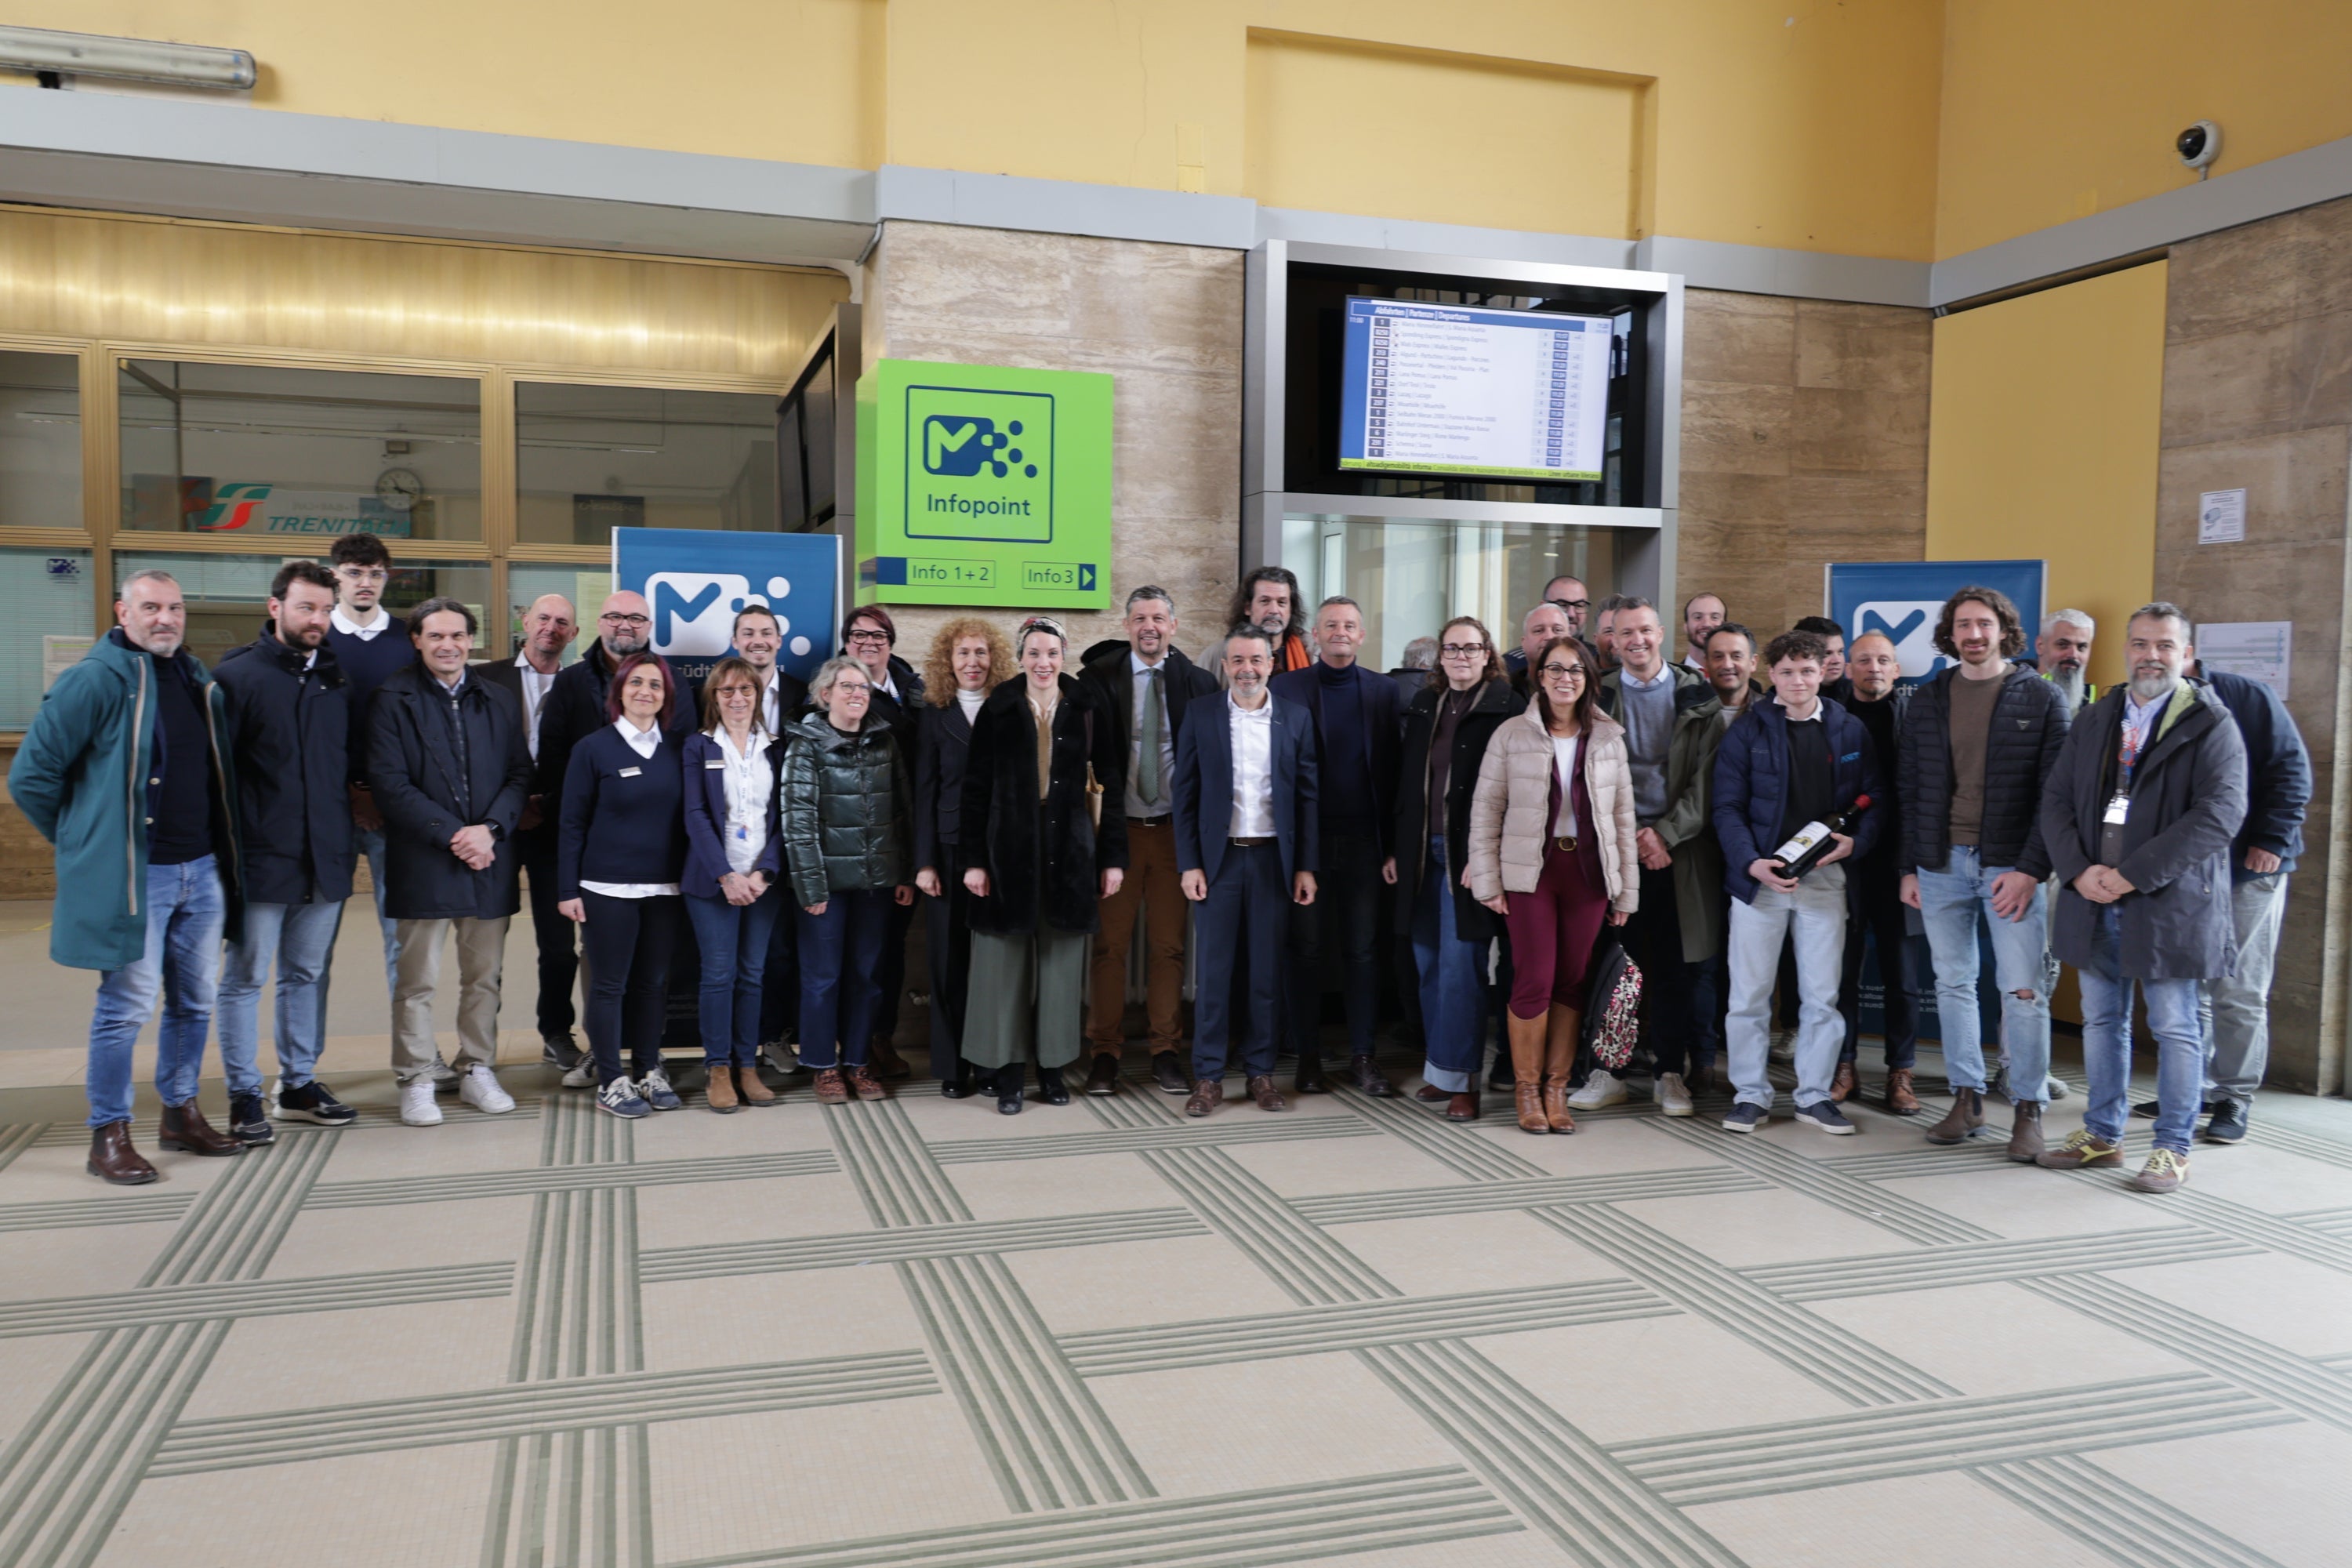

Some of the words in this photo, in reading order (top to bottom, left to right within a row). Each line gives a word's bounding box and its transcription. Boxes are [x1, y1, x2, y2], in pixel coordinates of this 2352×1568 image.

[927, 494, 1031, 517] Infopoint
[268, 516, 410, 535] TRENITALIA
[913, 564, 947, 579] Info
